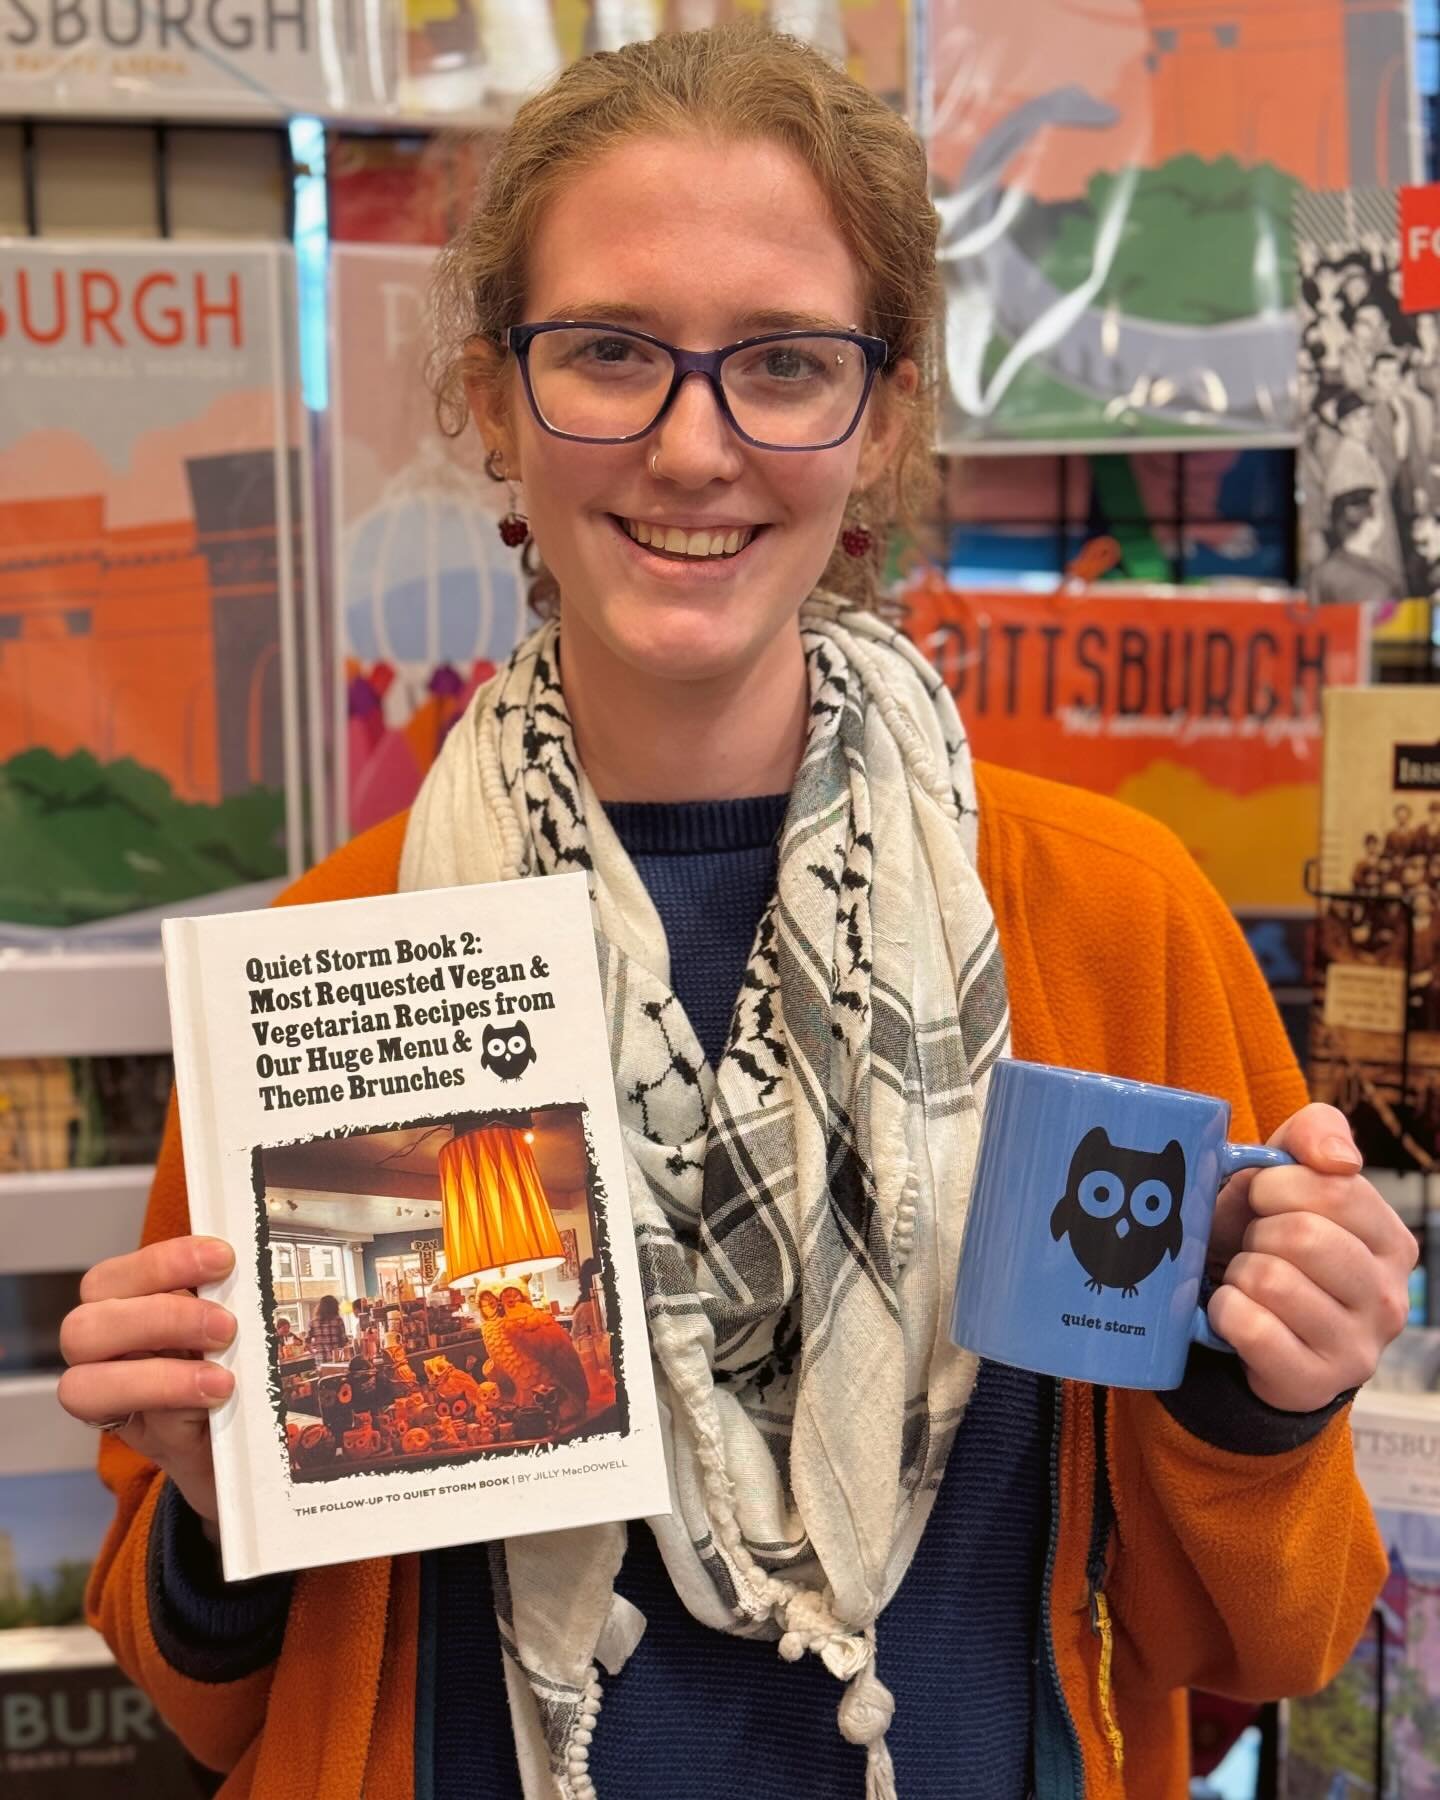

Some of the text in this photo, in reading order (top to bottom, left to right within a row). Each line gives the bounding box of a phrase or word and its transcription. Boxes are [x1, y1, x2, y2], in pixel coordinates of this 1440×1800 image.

[246, 931, 483, 982] Quiet Storm Book 2:
[249, 955, 551, 1014] Most Requested Vegan &
[252, 991, 556, 1048] Vegetarian Recipes from
[256, 1029, 473, 1079] Our Huge Menu &
[259, 1065, 466, 1111] Theme Brunches
[1061, 1313, 1146, 1336] quiet storm
[295, 1506, 318, 1518] THE
[319, 1495, 384, 1514] FOLLOW-UP
[386, 1492, 401, 1503] TO
[403, 1487, 437, 1502] QUIET
[439, 1481, 477, 1495] STORM
[479, 1475, 510, 1489] BOOK
[517, 1471, 532, 1484] BY
[533, 1468, 560, 1481] JILLY
[562, 1459, 629, 1477] MacDOWELL
